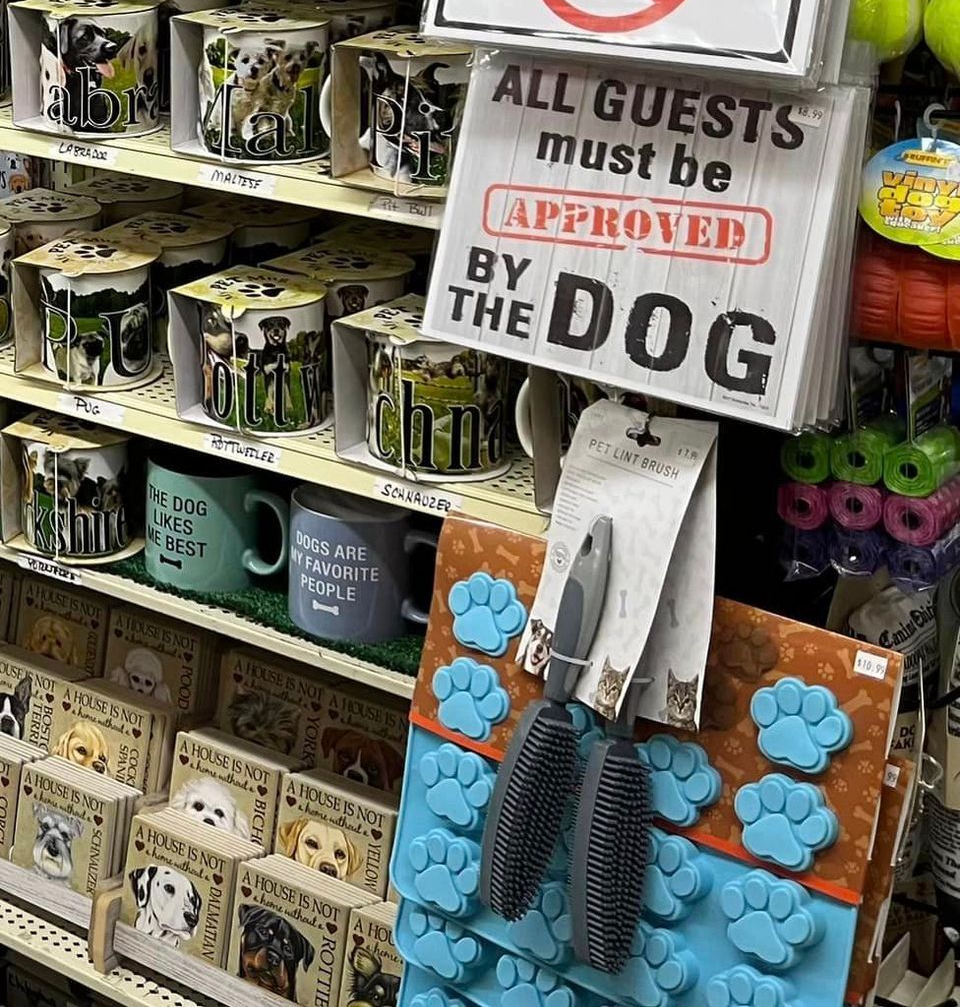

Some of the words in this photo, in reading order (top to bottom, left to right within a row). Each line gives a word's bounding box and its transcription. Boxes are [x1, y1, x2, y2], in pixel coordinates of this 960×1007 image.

[491, 64, 576, 115] ALL
[592, 78, 805, 151] GUESTS
[797, 106, 824, 121] $8.99
[58, 142, 108, 162] LABRADOR
[536, 129, 658, 179] must
[668, 142, 733, 193] be
[211, 169, 264, 190] MALTESE
[409, 202, 432, 216] Bull
[502, 197, 746, 250] APPROVED
[466, 246, 532, 292] BY
[448, 286, 535, 340] THE
[546, 271, 778, 396] DOG
[74, 397, 100, 416] PUG
[589, 438, 609, 456] PET
[613, 445, 639, 466] LINT
[641, 455, 680, 480] BRUSH
[149, 484, 168, 508] THE
[173, 497, 208, 516] DOG
[381, 484, 452, 511] SCHNAUZER
[153, 512, 193, 535] LIKES
[165, 535, 207, 558] BEST
[296, 530, 330, 556] DOGS
[335, 545, 367, 561] ARE
[306, 556, 379, 582] FAVORITE
[301, 573, 357, 602] PEOPLE
[35, 777, 69, 799] HOUSE
[71, 791, 81, 804] IS
[83, 796, 106, 815] NOT
[147, 832, 186, 855] HOUSE
[188, 842, 198, 857] IS
[200, 851, 226, 874] NOT
[364, 843, 382, 890] YELLOW
[203, 887, 222, 960] DALMATIAN
